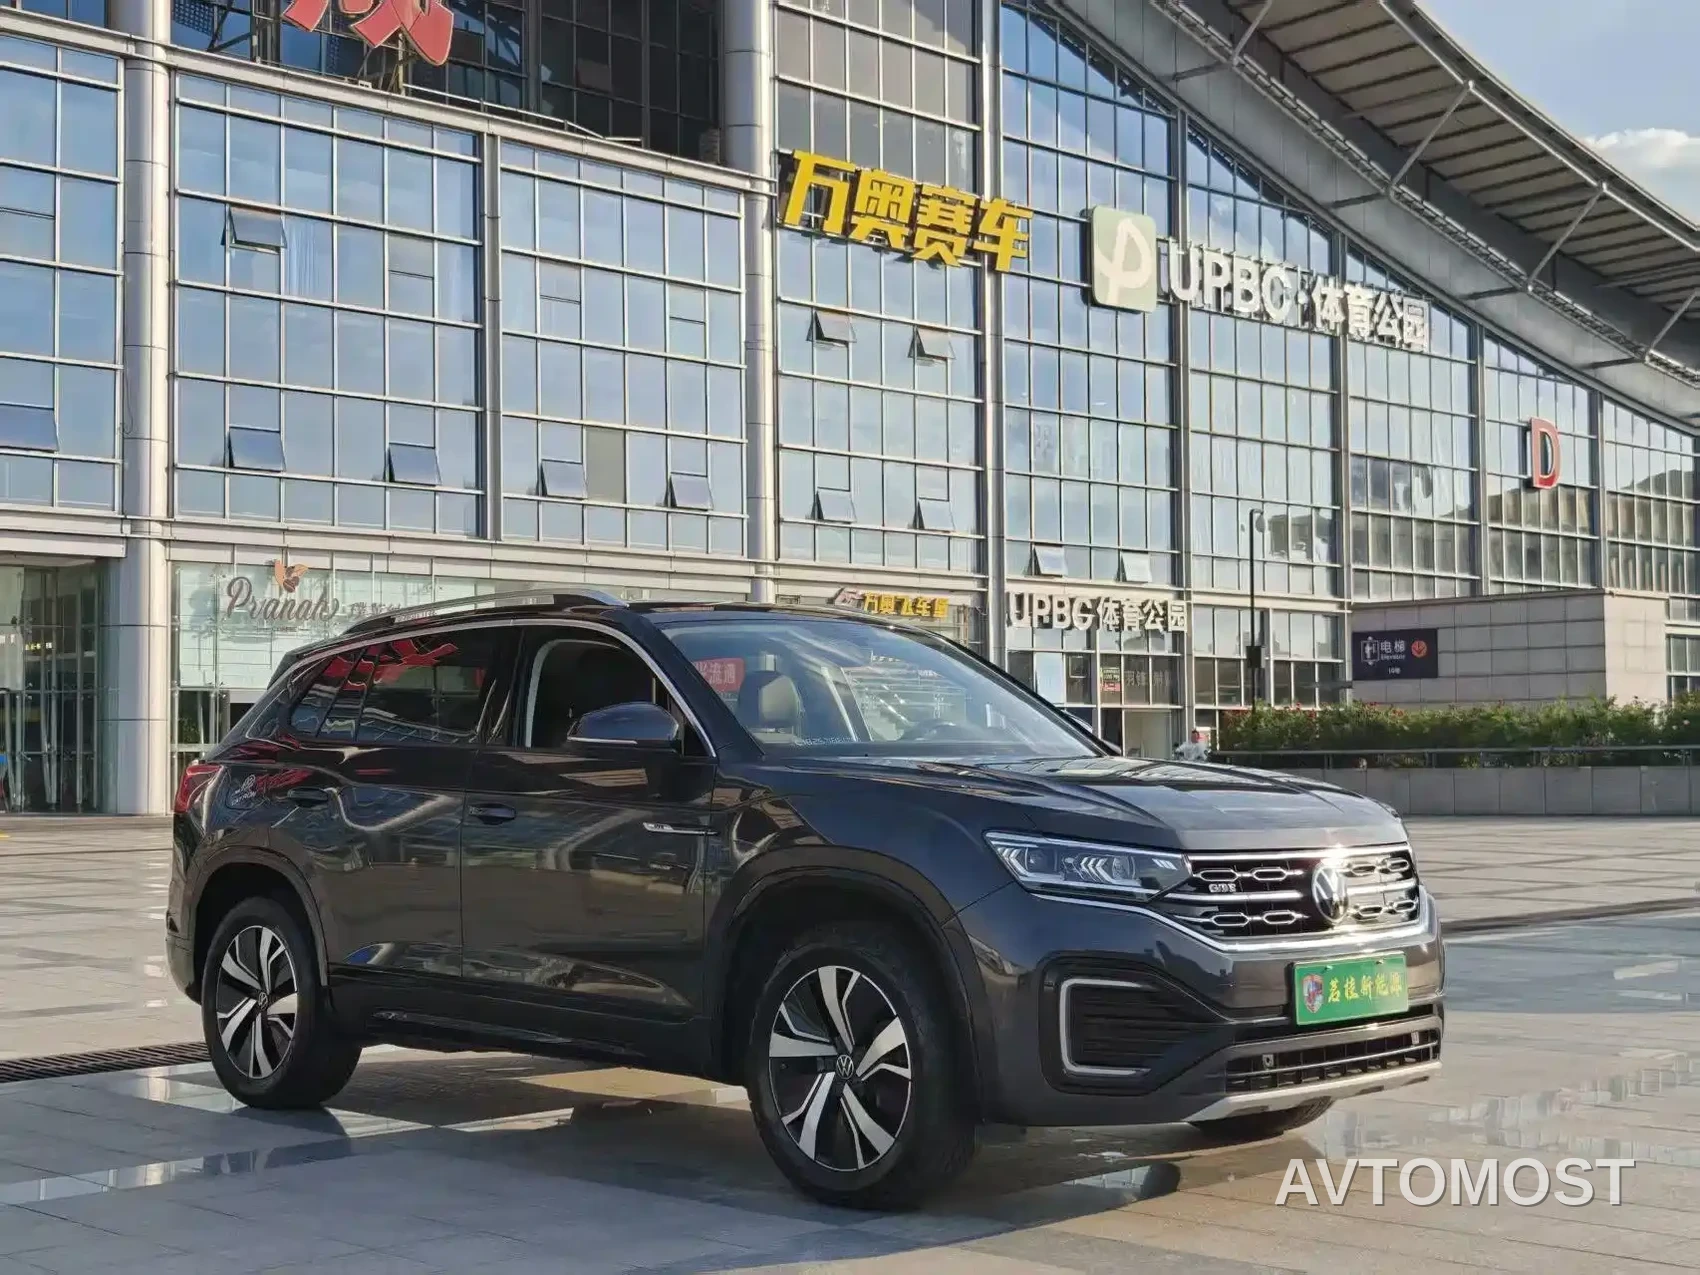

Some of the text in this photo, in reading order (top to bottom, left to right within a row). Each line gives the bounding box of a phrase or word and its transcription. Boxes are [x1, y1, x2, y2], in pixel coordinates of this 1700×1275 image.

[784, 150, 1034, 272] 万奥赛车
[1530, 416, 1560, 490] D
[1380, 640, 1405, 654] 电梯
